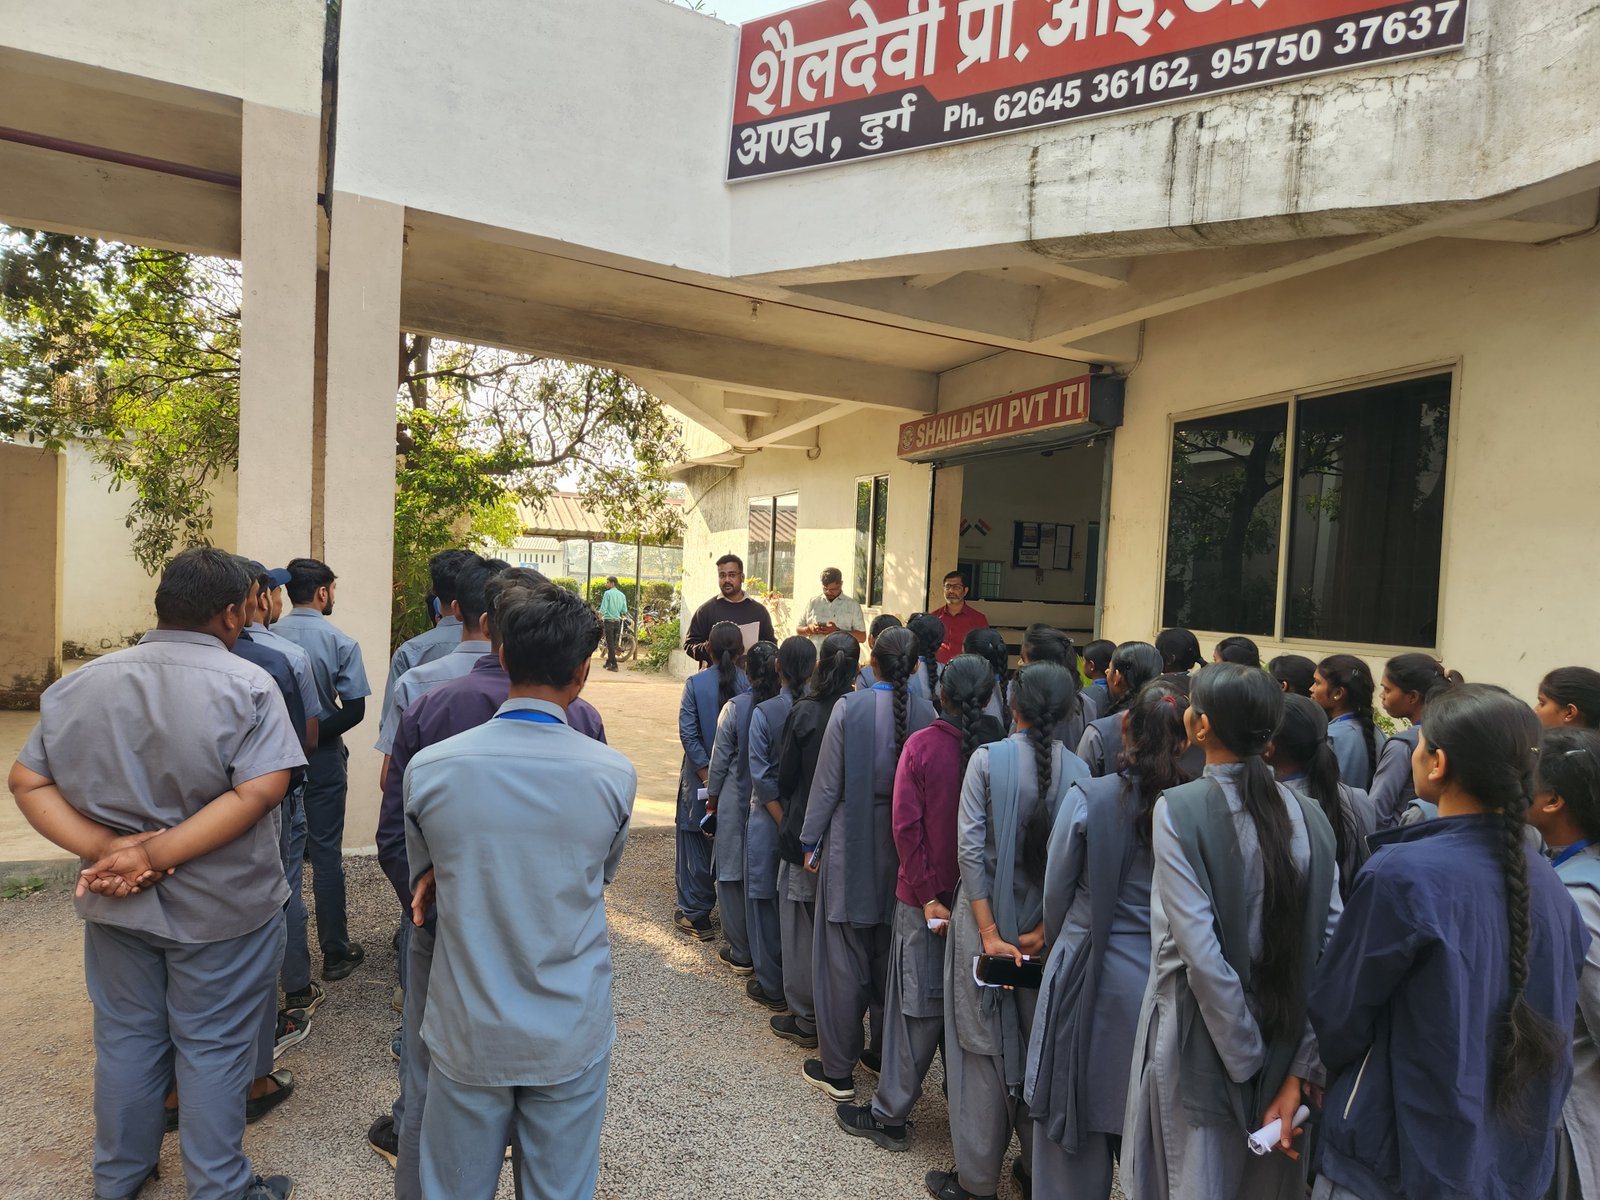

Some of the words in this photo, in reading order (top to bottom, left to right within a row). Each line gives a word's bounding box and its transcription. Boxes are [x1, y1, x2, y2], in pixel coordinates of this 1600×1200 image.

[746, 0, 945, 116] शैलदेवी
[943, 102, 984, 132] Ph.
[993, 78, 1081, 123] 62645
[1090, 56, 1198, 103] 36162,
[1210, 30, 1321, 80] 95750
[1333, 0, 1460, 55] 37637
[736, 111, 842, 165] अण्डा,
[859, 93, 917, 150] दुर्ग
[916, 403, 1003, 448] SHAILDEVI
[1008, 391, 1049, 428] PVT
[1055, 382, 1085, 418] ITI
